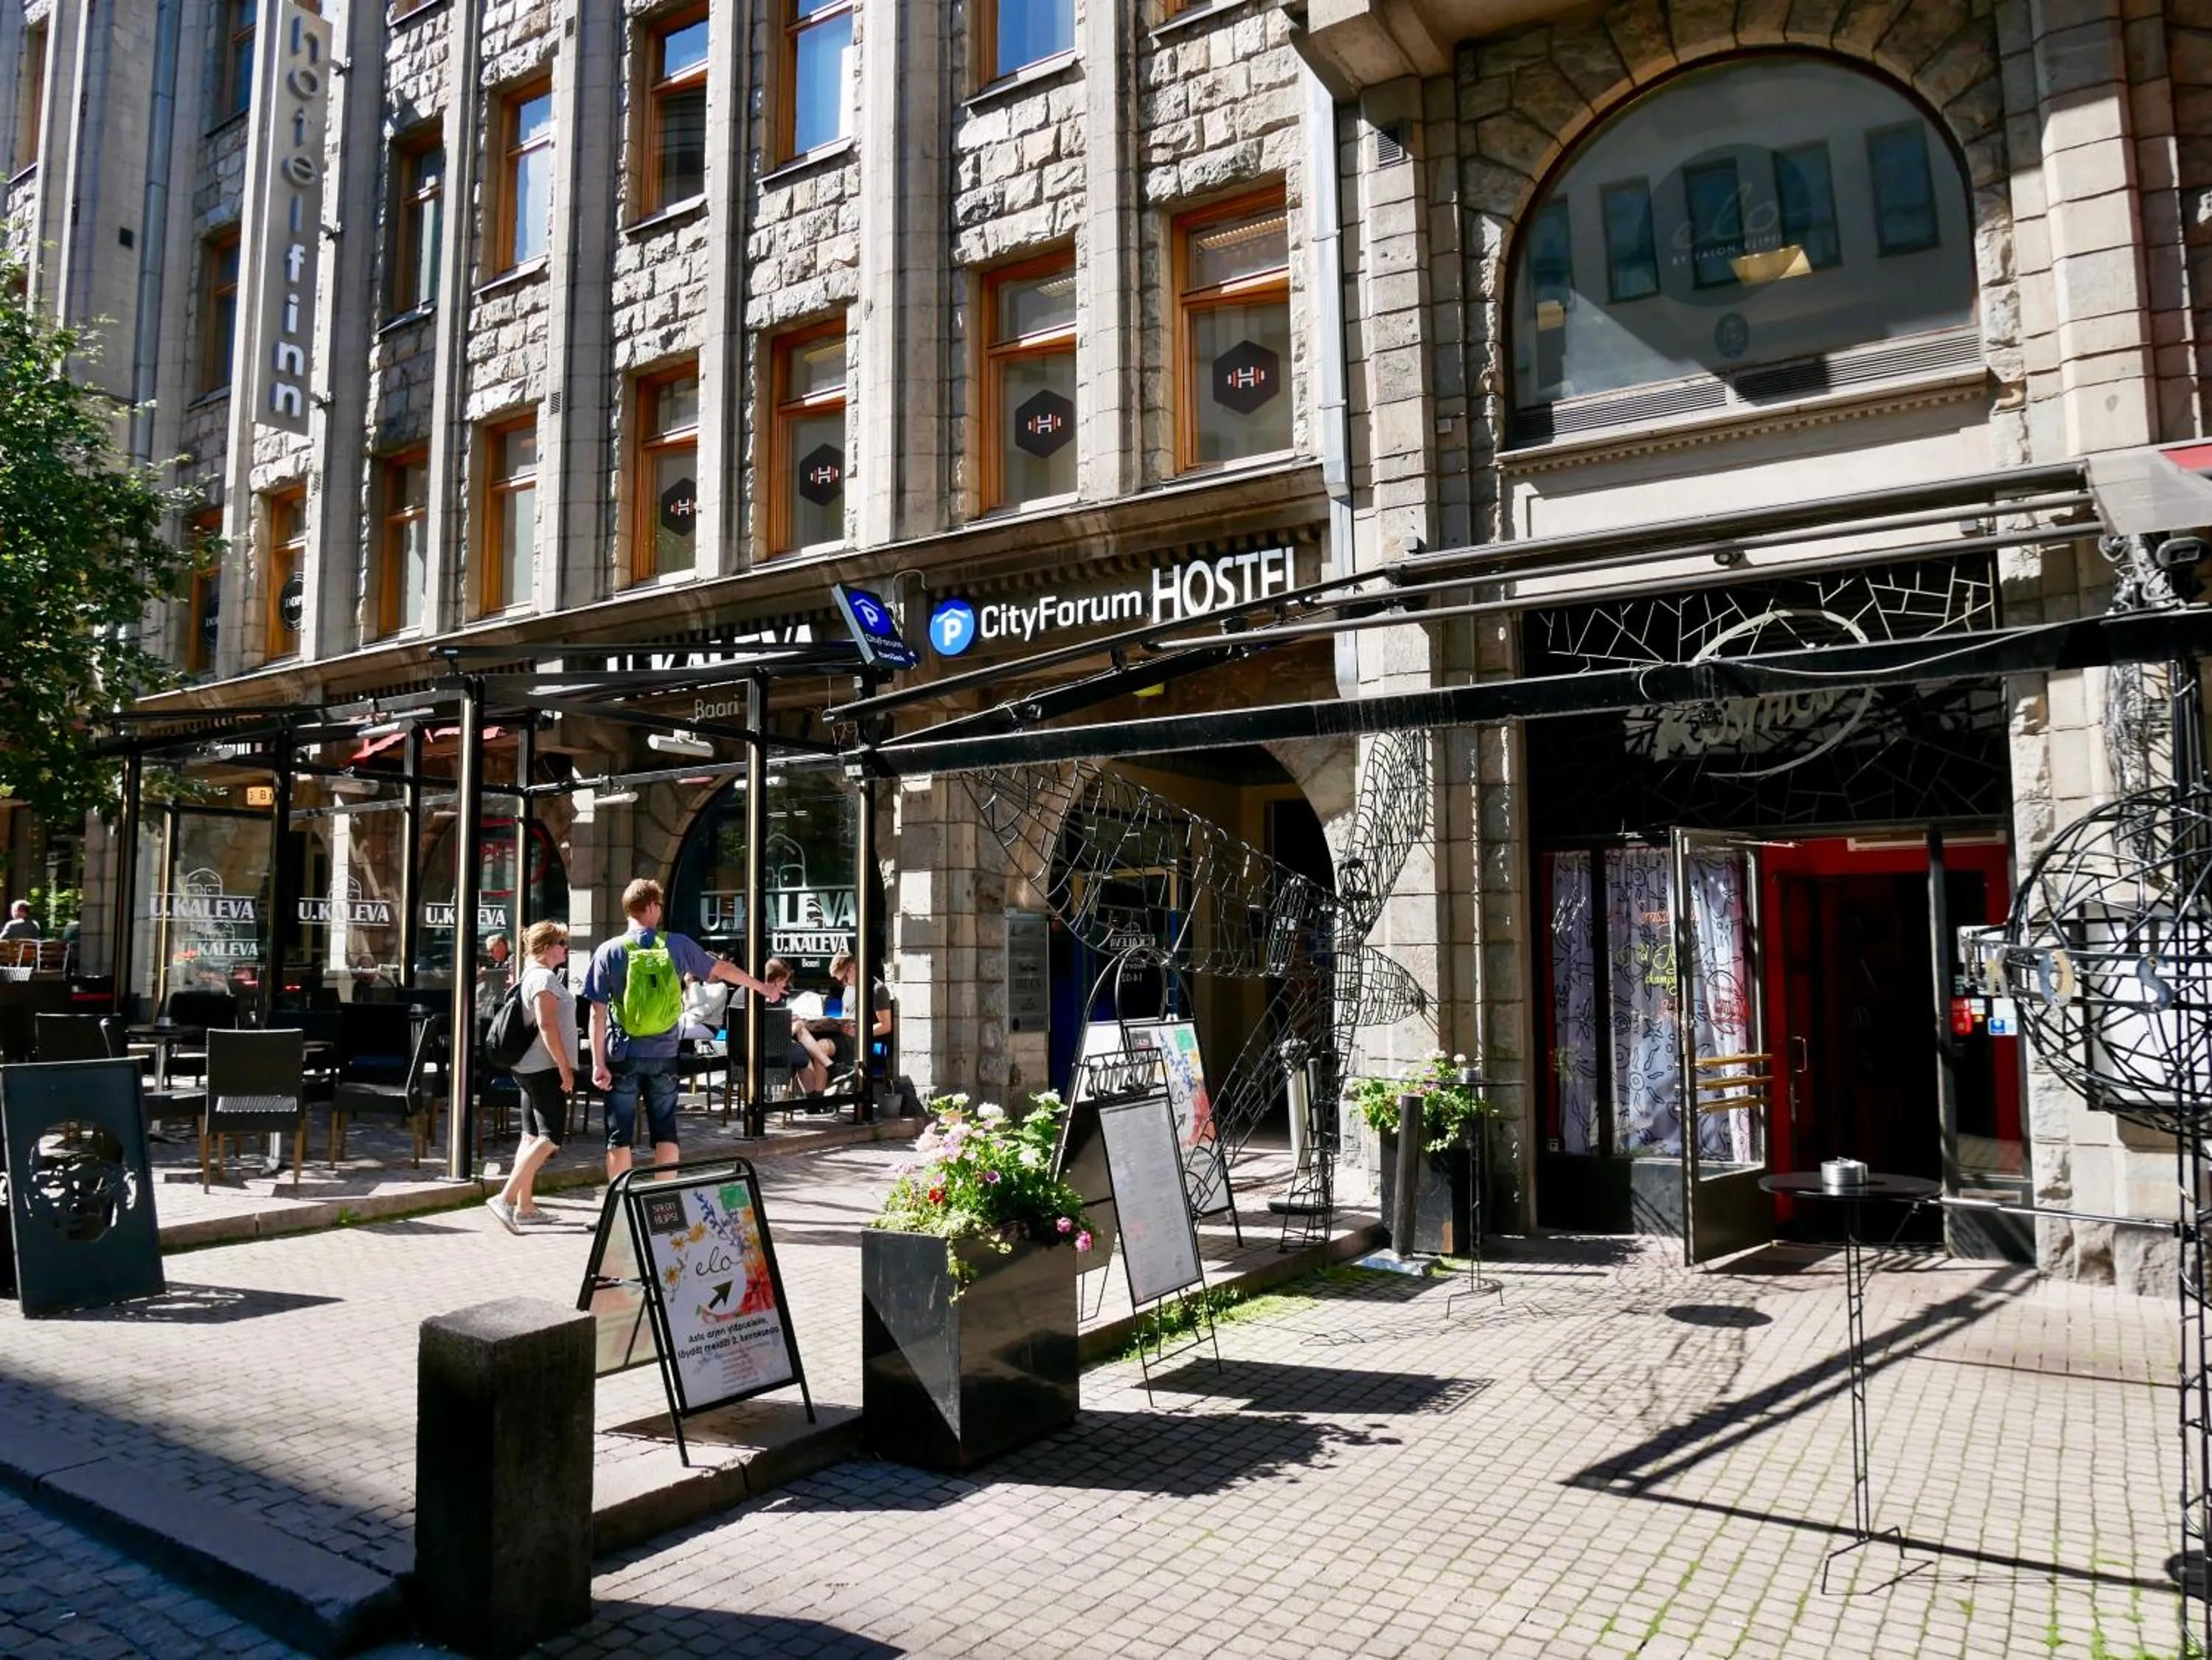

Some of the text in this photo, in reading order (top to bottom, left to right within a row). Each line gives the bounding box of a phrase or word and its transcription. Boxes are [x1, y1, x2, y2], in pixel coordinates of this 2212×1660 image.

[981, 590, 1142, 641] CityForum
[695, 694, 740, 719] Baari
[425, 906, 507, 925] U.KEVA
[773, 932, 849, 953] U.KALEVA
[696, 1246, 740, 1276] elo
